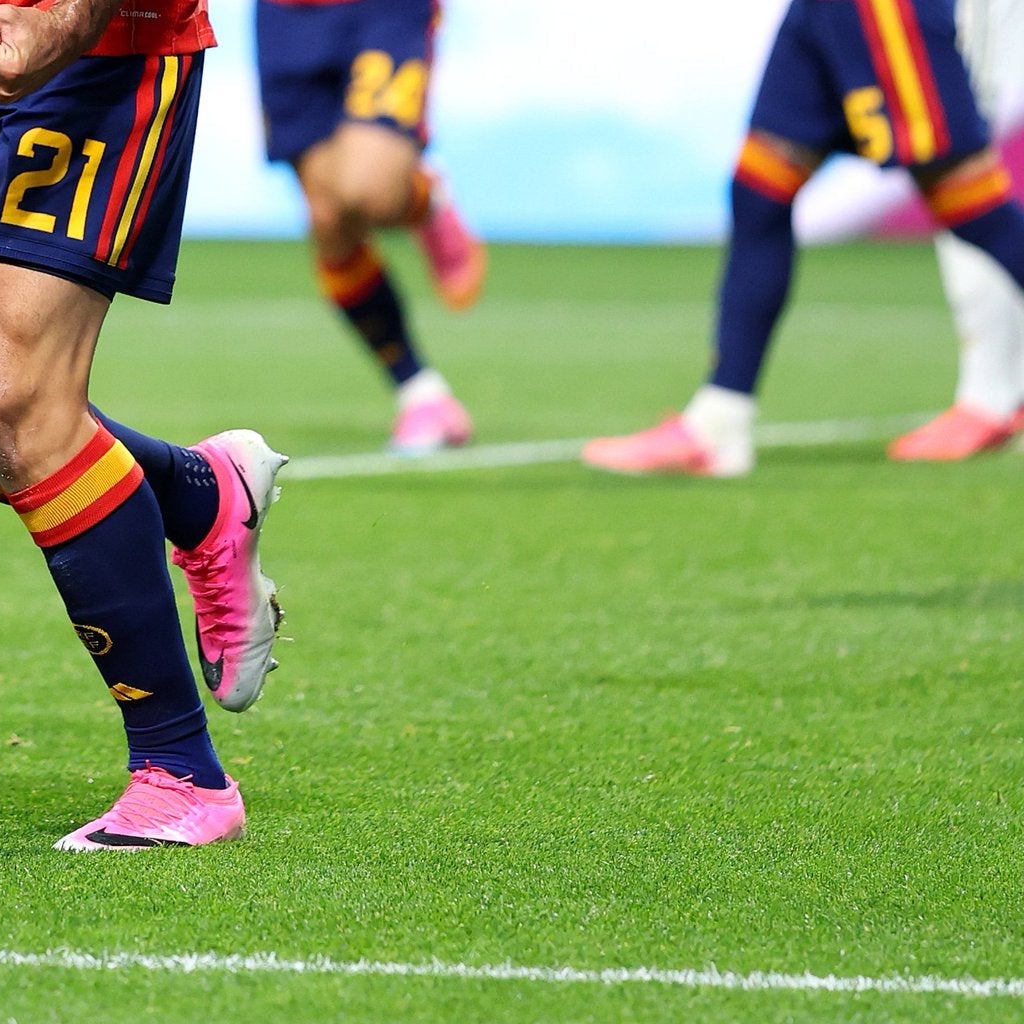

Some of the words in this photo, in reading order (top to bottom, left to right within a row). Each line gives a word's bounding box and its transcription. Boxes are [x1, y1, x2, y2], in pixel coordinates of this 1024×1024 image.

[345, 49, 429, 127] 24
[843, 85, 894, 165] 5
[0, 127, 107, 241] 21
